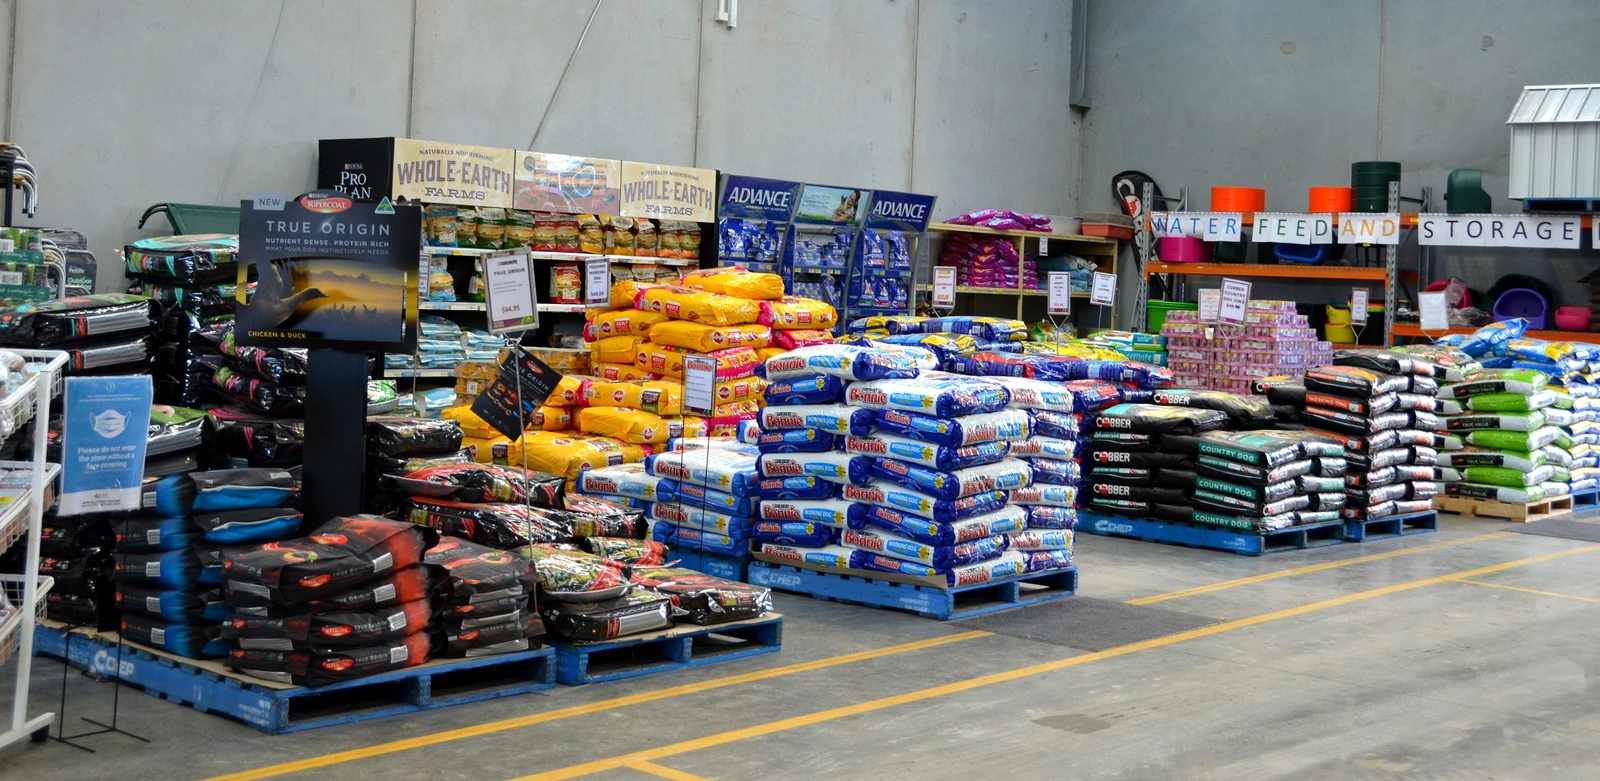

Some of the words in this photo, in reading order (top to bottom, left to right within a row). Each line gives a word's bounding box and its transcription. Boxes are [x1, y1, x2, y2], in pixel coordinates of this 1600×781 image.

[456, 150, 494, 162] NOURISHING
[340, 172, 366, 186] PRO
[397, 160, 456, 184] WHOLE
[462, 162, 510, 194] EARTH
[424, 187, 486, 200] FARMS
[624, 180, 670, 203] WHOLE
[674, 183, 712, 210] EARTH
[728, 187, 791, 207] ADVANCE
[259, 198, 281, 206] NEW
[645, 204, 693, 216] FARMS
[872, 200, 926, 219] ADVANCE
[266, 220, 311, 233] TRUE
[321, 222, 390, 236] ORIGIN
[1151, 218, 1236, 234] WATER
[1259, 218, 1328, 236] FEED
[1341, 219, 1395, 236] AND
[1424, 220, 1574, 240] STORAGE
[502, 305, 520, 313] $64.95
[248, 330, 278, 338] CHICKEN
[768, 358, 806, 372] Bonnie
[527, 372, 549, 391] ORIGIN
[850, 388, 888, 404] Bonnie
[1154, 394, 1190, 404] COBBER
[766, 414, 802, 427] Bonnie
[1096, 417, 1131, 428] COBBER
[848, 438, 887, 453] Bonnie
[1094, 451, 1130, 462] COBBER
[1201, 445, 1235, 457] COUNTRY
[1238, 452, 1254, 462] DOG
[765, 462, 801, 474] Bonnie
[586, 478, 617, 493] Bonnie
[1094, 484, 1130, 496] COBBER
[1199, 480, 1232, 492] COUNTRY
[1235, 487, 1252, 497] DOG
[846, 487, 884, 503] Bonnie
[764, 507, 800, 520] Bonnie
[877, 509, 903, 524] Bonnie
[1108, 523, 1132, 533] CHEP
[1195, 514, 1228, 525] COUNTRY
[1231, 519, 1248, 528] DOG
[845, 532, 884, 550] Bonnie
[875, 556, 900, 570] Bonnie
[770, 573, 800, 586] CHEP
[959, 571, 989, 585] Bonnie
[348, 593, 371, 601] ORIGIN
